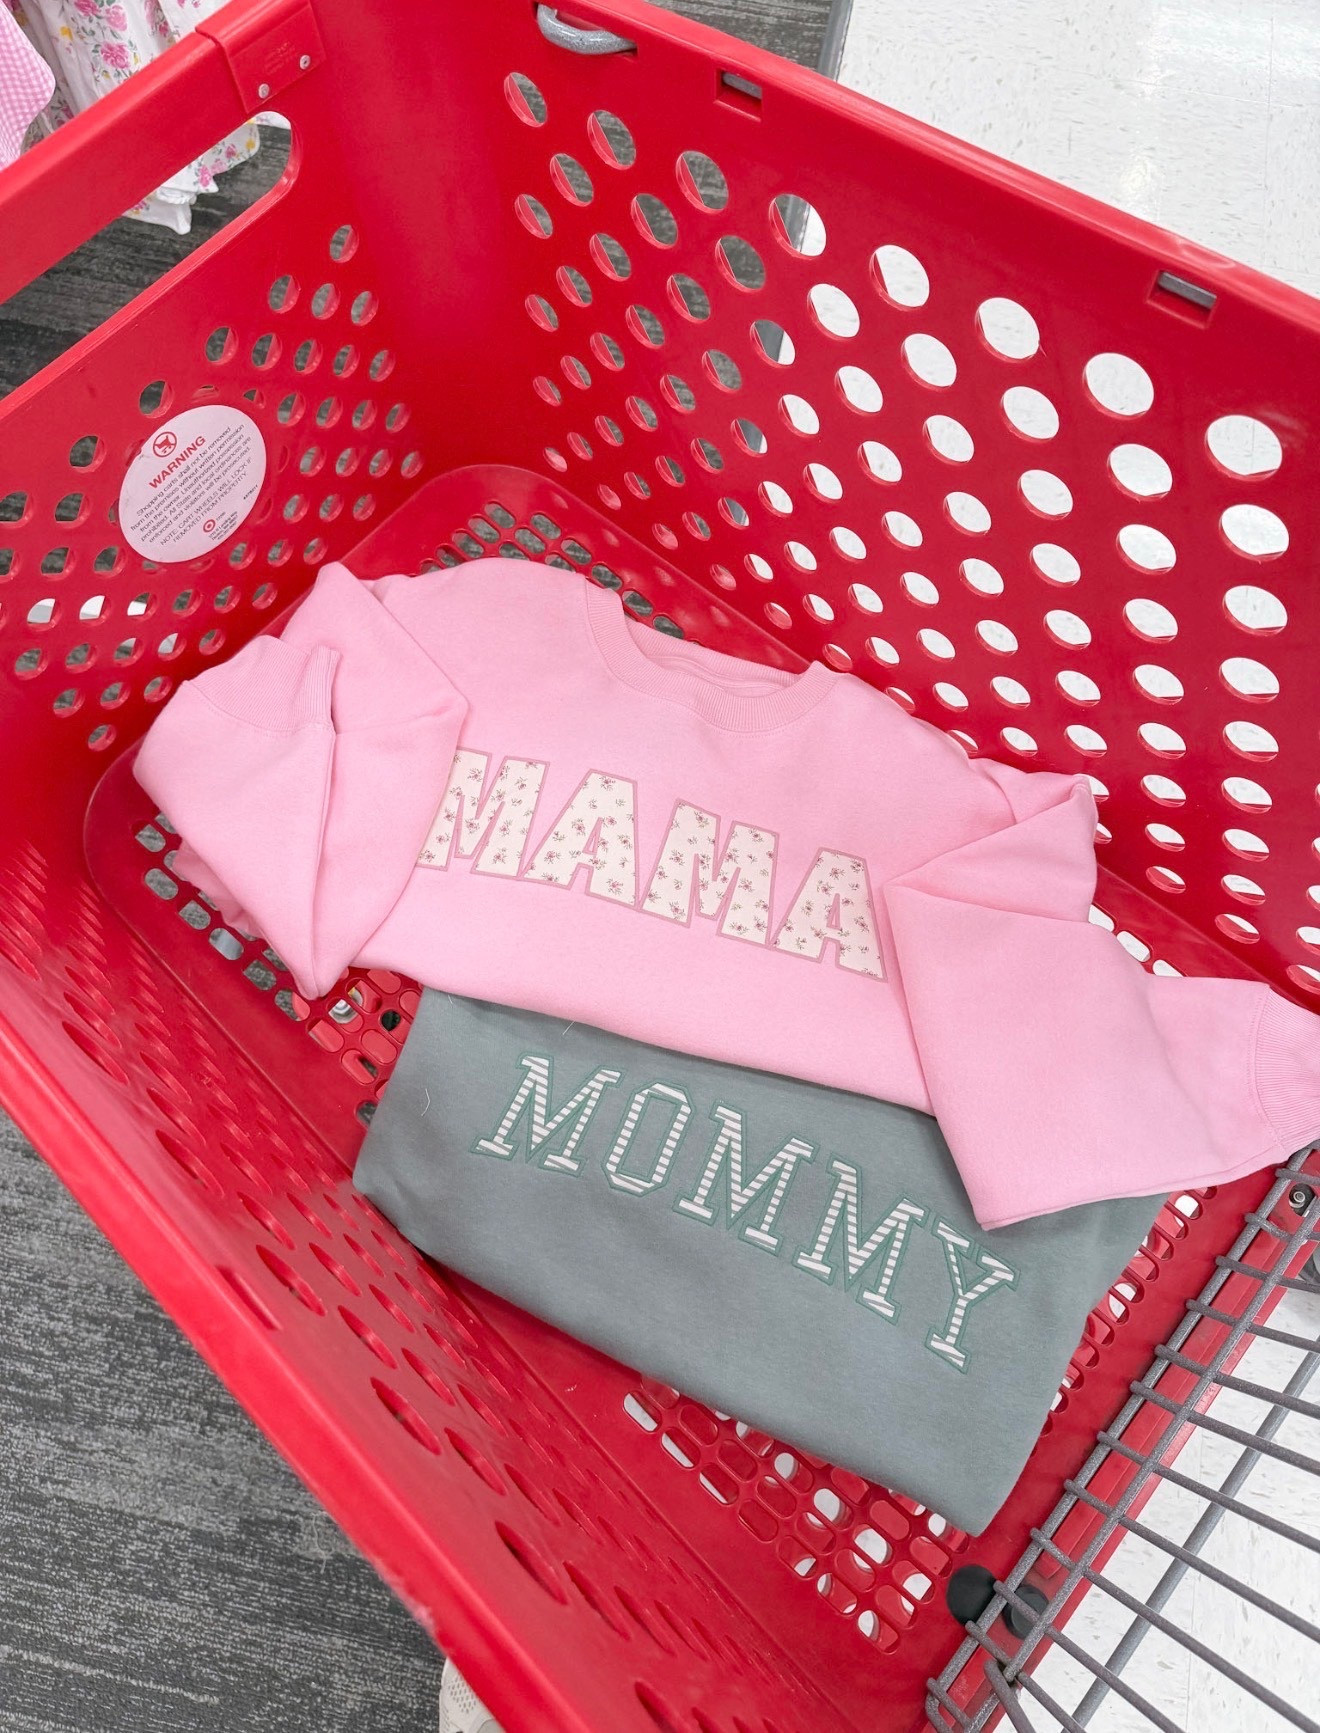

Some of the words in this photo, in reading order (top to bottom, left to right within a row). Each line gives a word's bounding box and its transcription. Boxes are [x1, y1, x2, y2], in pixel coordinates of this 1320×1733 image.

[136, 490, 164, 517] Shopping
[162, 477, 178, 492] carts
[177, 465, 190, 478] shall
[190, 456, 200, 466] not
[149, 434, 206, 489] WARNING
[417, 747, 887, 981] MAMA
[473, 1053, 1019, 1373] MOMMY
